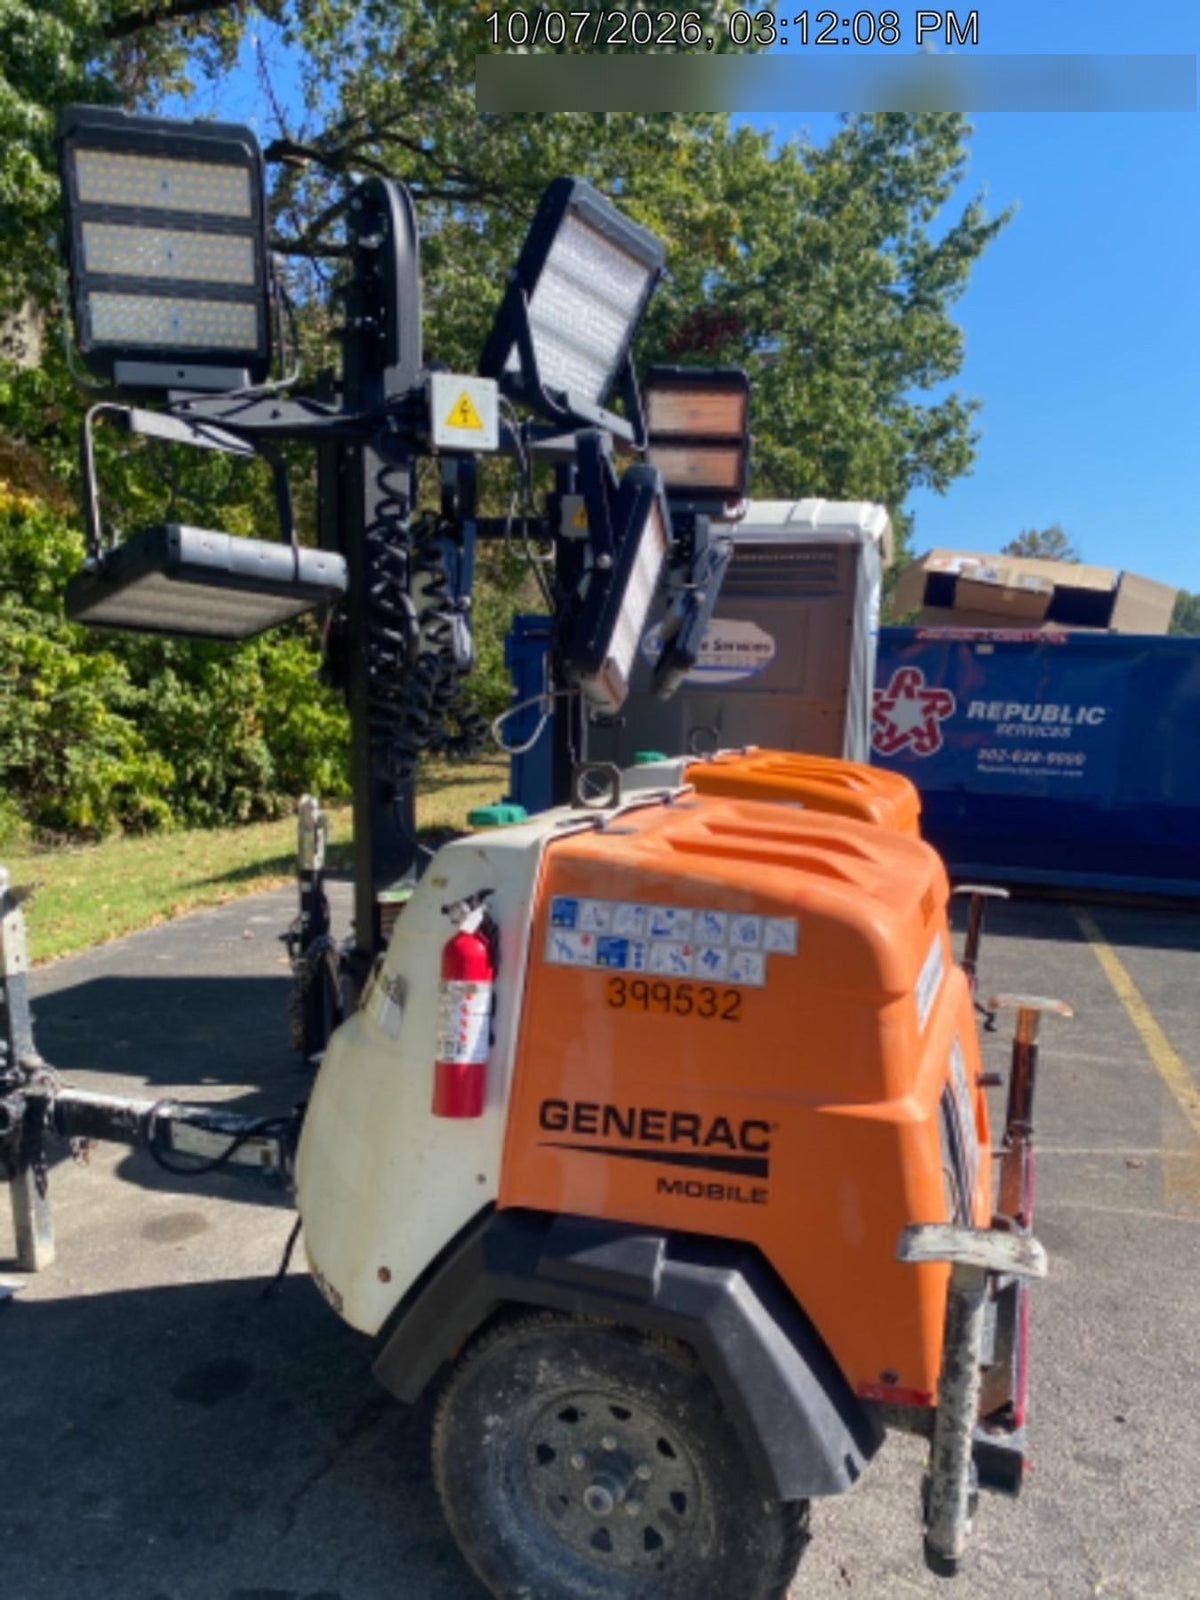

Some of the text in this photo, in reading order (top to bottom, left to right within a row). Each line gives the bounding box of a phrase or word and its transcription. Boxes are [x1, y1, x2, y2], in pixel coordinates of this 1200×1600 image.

[966, 700, 1107, 725] REPUBLIC
[607, 976, 743, 1021] 399532
[538, 1098, 772, 1153] GENERAC
[655, 1177, 769, 1204] MOBILE
